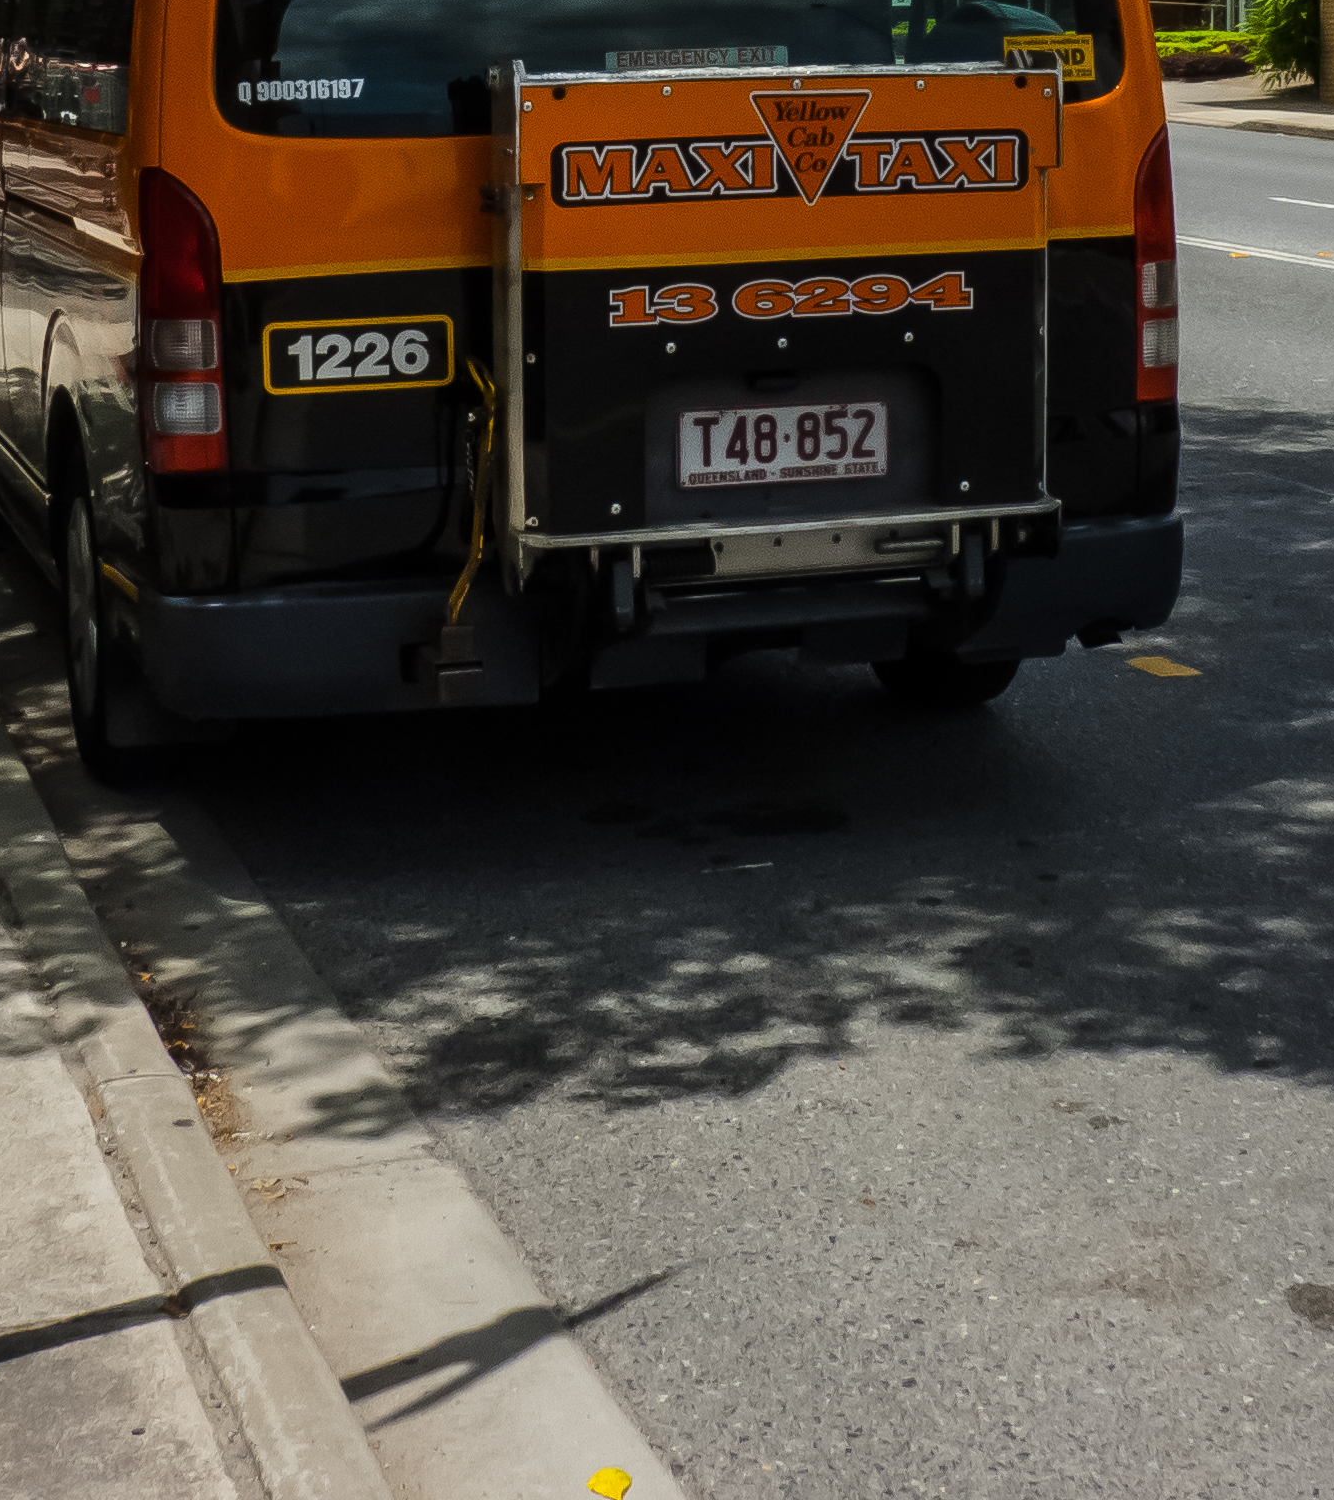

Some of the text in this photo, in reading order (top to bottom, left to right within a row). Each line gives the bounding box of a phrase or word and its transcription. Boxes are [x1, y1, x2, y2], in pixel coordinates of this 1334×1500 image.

[617, 46, 775, 68] EMERGENCY EXIT
[237, 78, 365, 106] Q 900316197
[773, 101, 851, 121] Yellow
[788, 126, 835, 148] Cab
[562, 136, 1019, 200] MAXI TAXI
[794, 152, 827, 173] Co
[609, 271, 974, 327] 13 6294
[287, 329, 430, 381] 1226
[688, 461, 880, 485] QUEENSLAND SUNSHINE STATE
